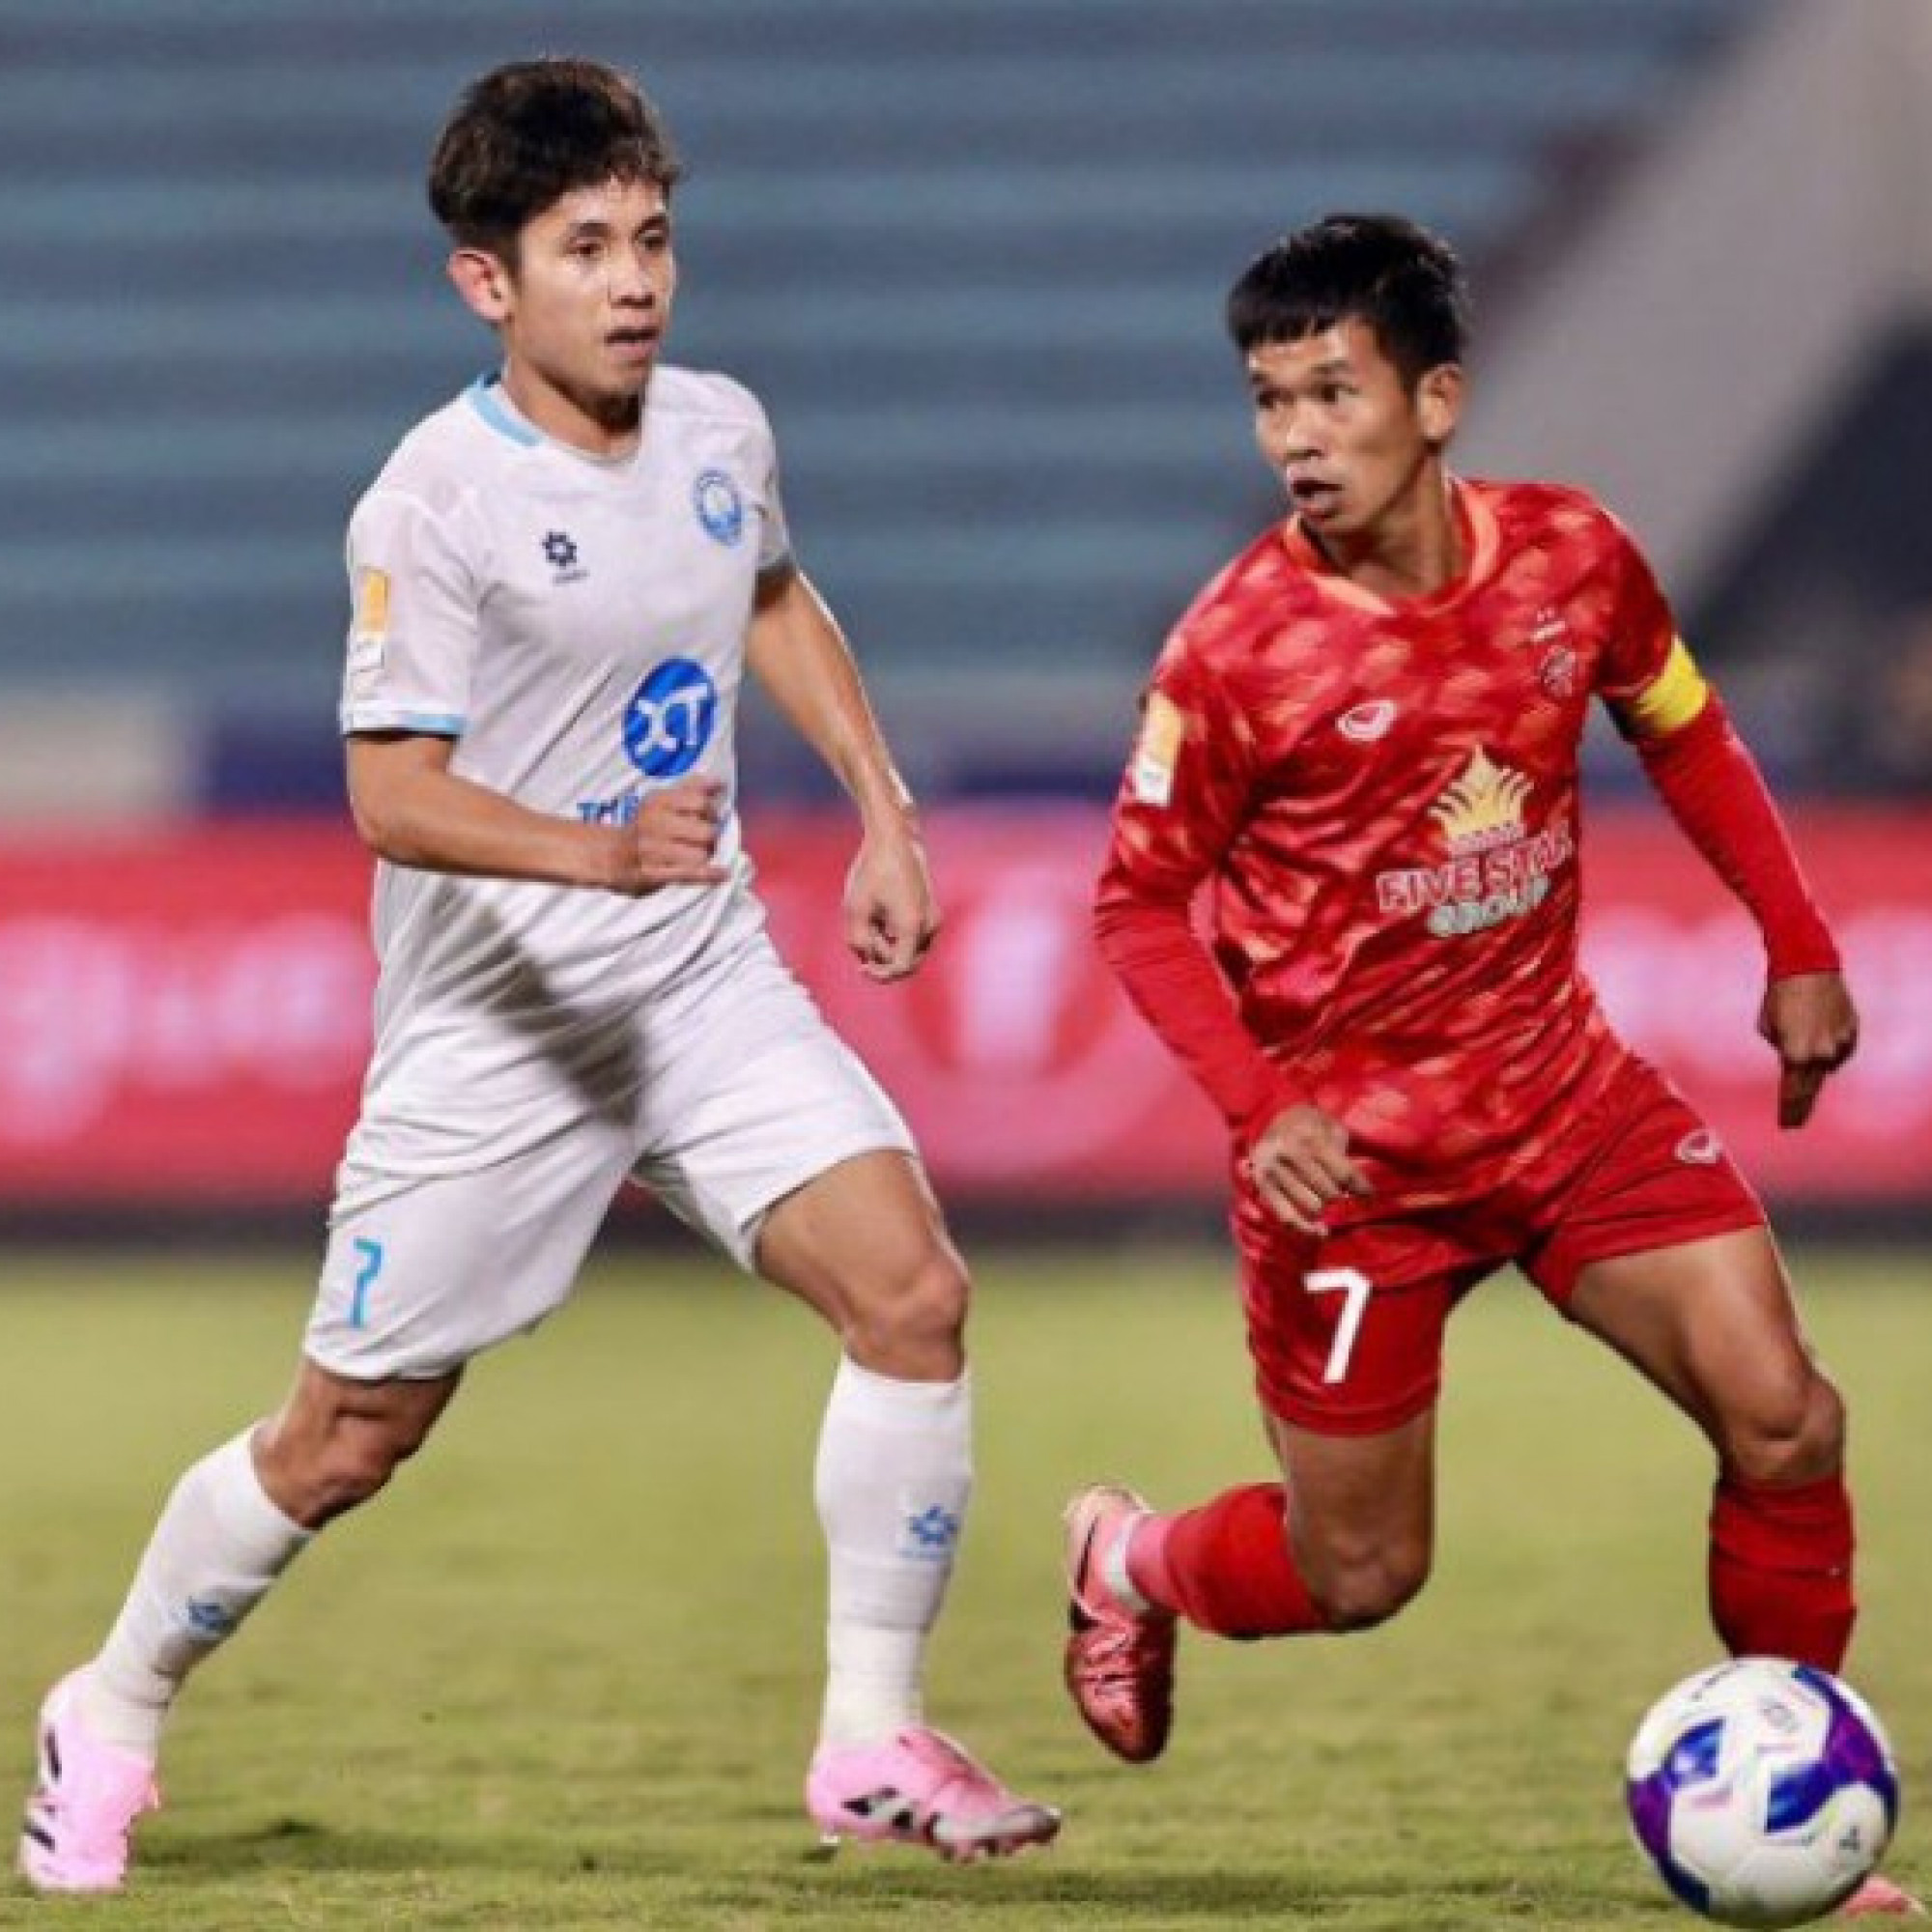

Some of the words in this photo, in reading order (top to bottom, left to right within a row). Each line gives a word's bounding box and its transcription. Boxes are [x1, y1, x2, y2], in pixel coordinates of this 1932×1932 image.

[1376, 860, 1480, 915] FIVE
[353, 1237, 383, 1329] 7
[1303, 1267, 1373, 1383] 7
